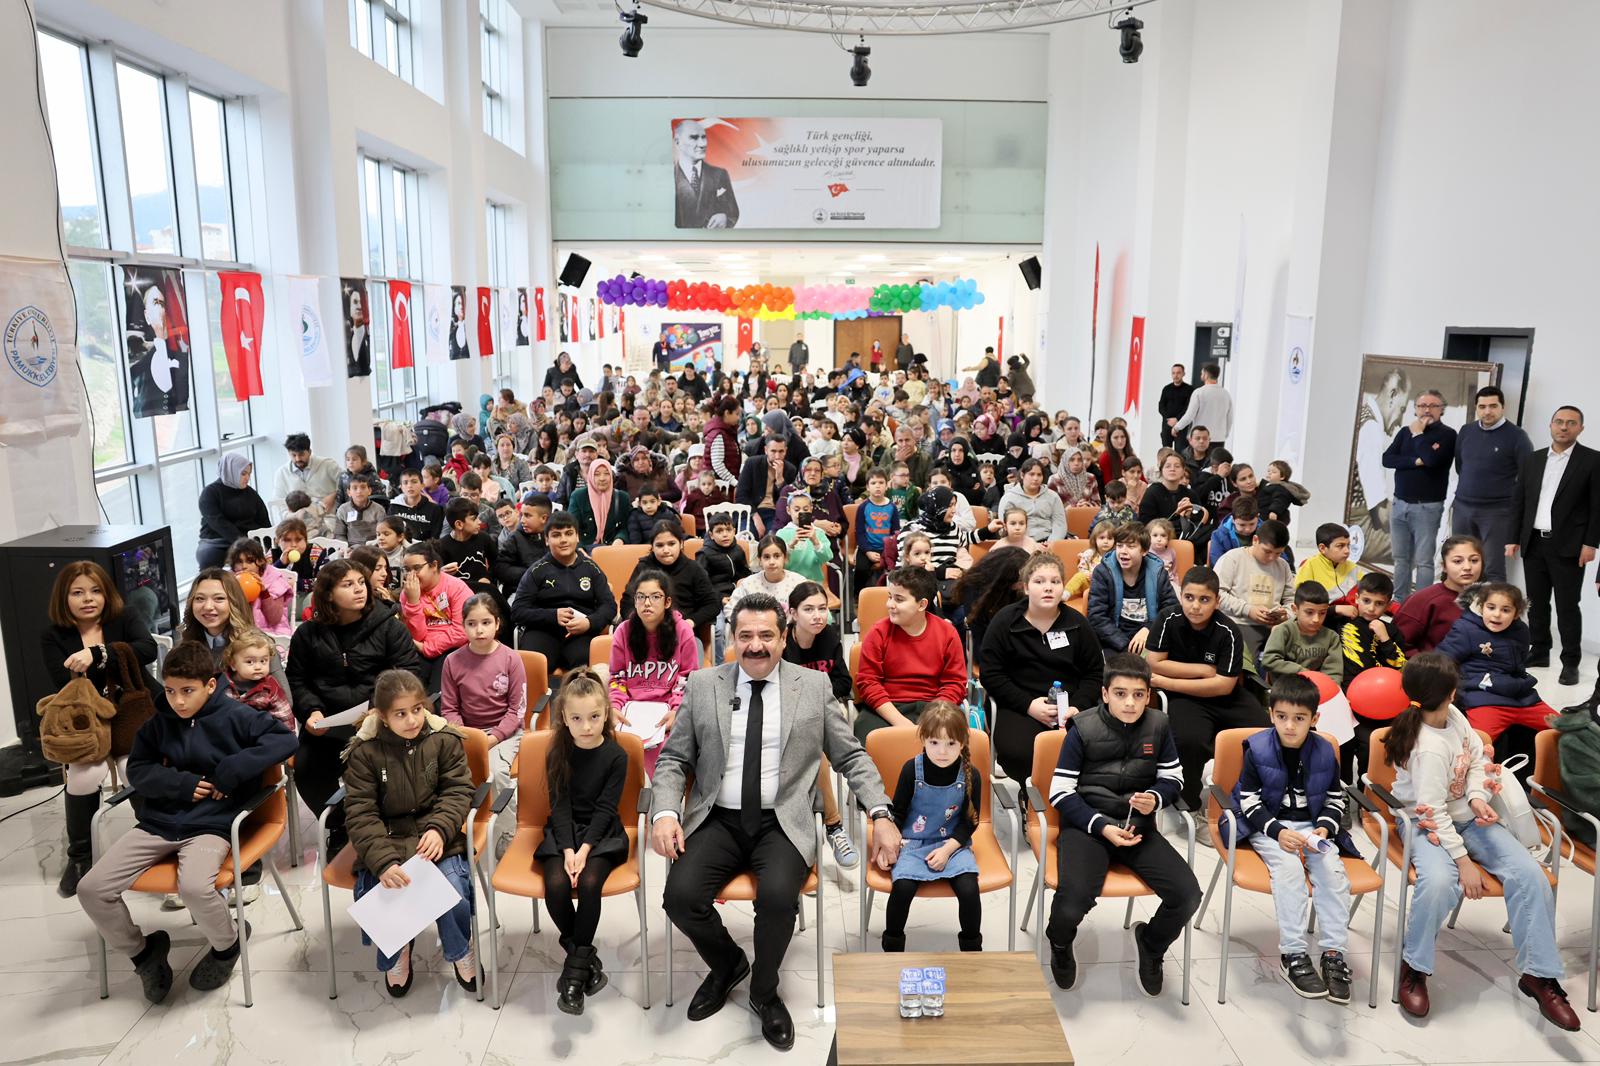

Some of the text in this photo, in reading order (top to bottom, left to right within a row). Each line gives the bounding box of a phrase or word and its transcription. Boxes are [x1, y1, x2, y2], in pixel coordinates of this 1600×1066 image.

[806, 131, 872, 142] Türk gençliği,
[773, 144, 905, 155] sağlıklı yetişip spor yaparsa
[742, 157, 936, 168] ulusumuzun geleceği güvence altındadır.
